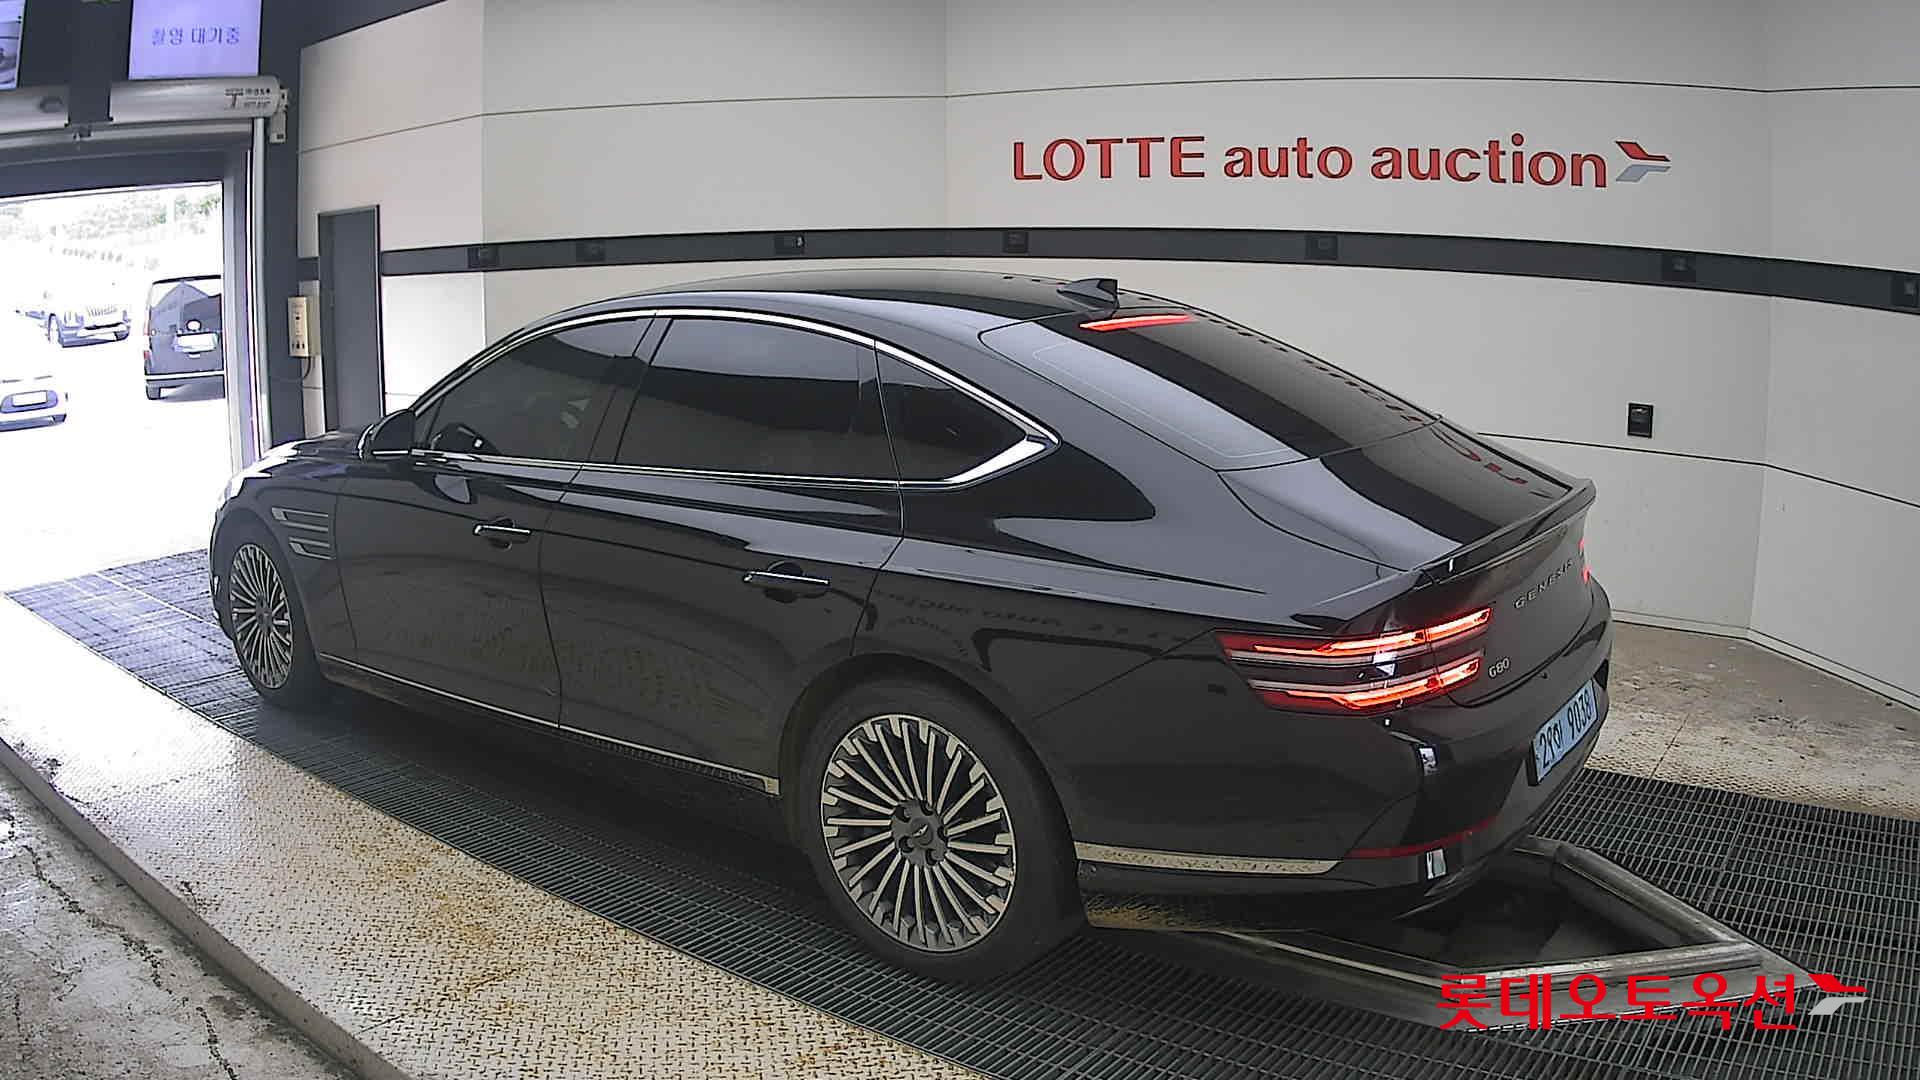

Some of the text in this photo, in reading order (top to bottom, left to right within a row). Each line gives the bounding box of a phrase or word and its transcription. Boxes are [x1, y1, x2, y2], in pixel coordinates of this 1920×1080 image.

[191, 26, 239, 45] 대기중
[1013, 133, 1606, 188] LOTTE auto auction
[1488, 656, 1512, 679] G80
[1567, 688, 1592, 741] 9038
